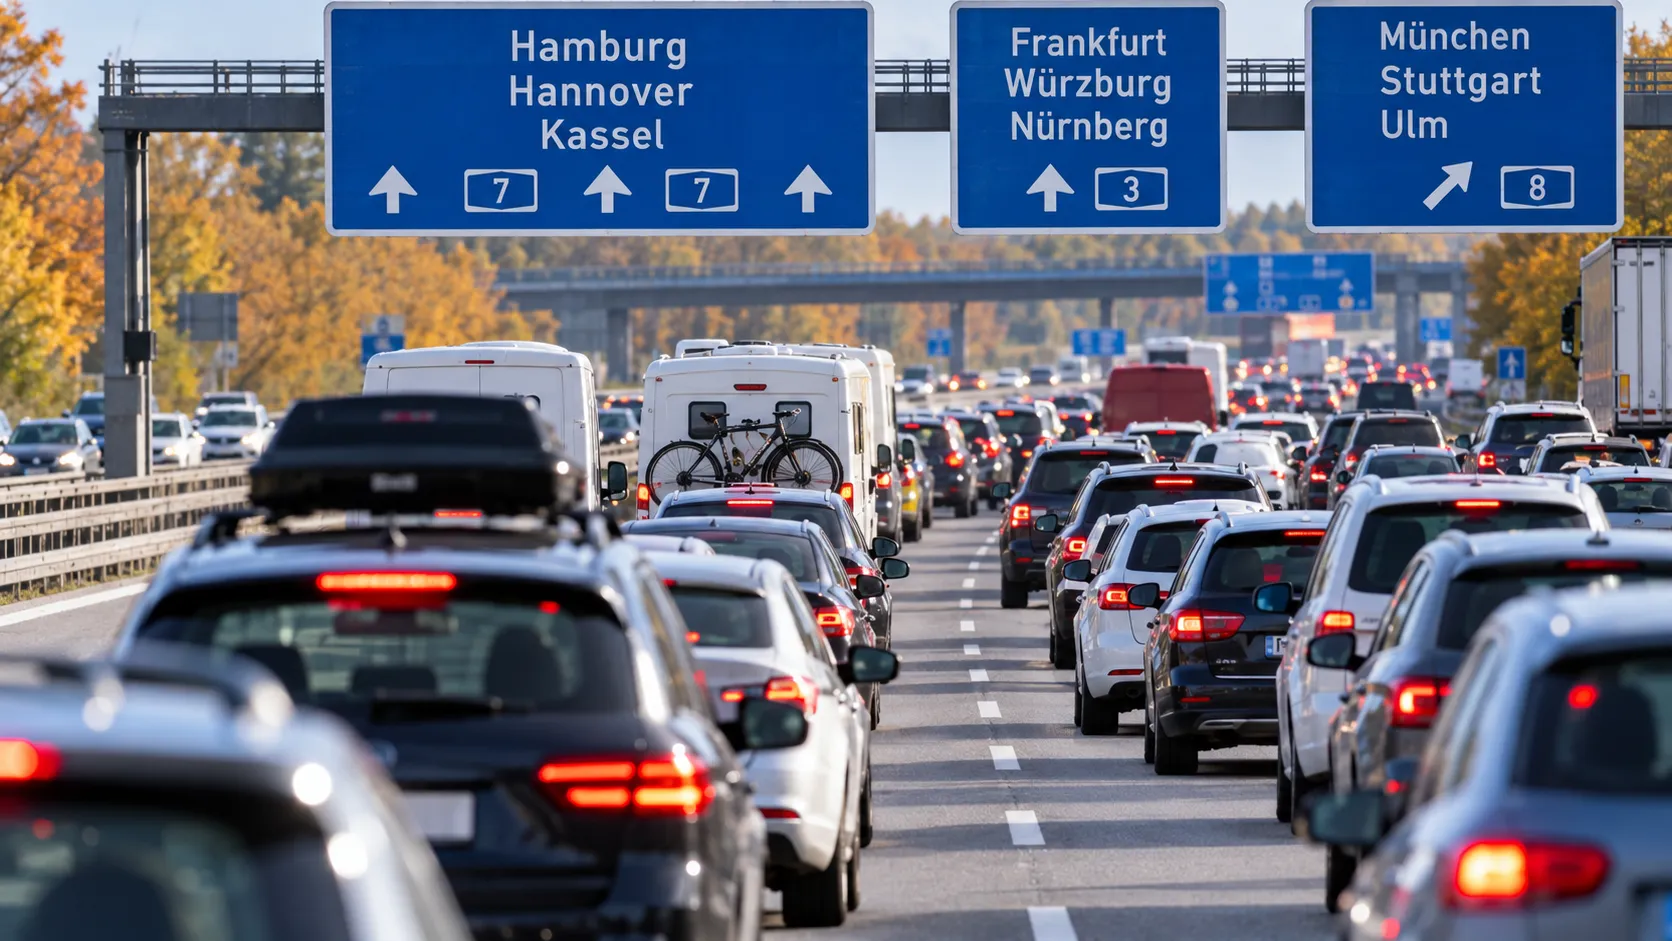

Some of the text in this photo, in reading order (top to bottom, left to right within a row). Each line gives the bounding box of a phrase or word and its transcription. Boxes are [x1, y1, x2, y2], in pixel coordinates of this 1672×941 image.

[511, 30, 686, 70] Hamburg
[1012, 27, 1167, 57] Frankfurt
[1380, 21, 1530, 51] München
[510, 75, 694, 107] Hannover
[1004, 67, 1171, 104] Würzburg
[1380, 66, 1542, 103] Stuttgart
[541, 119, 664, 150] Kassel
[1011, 110, 1168, 148] Nürnberg
[1381, 110, 1448, 139] Ulm
[493, 178, 509, 204] 7
[694, 178, 711, 204] 7
[1123, 176, 1139, 203] 3
[1528, 175, 1545, 202] 8
